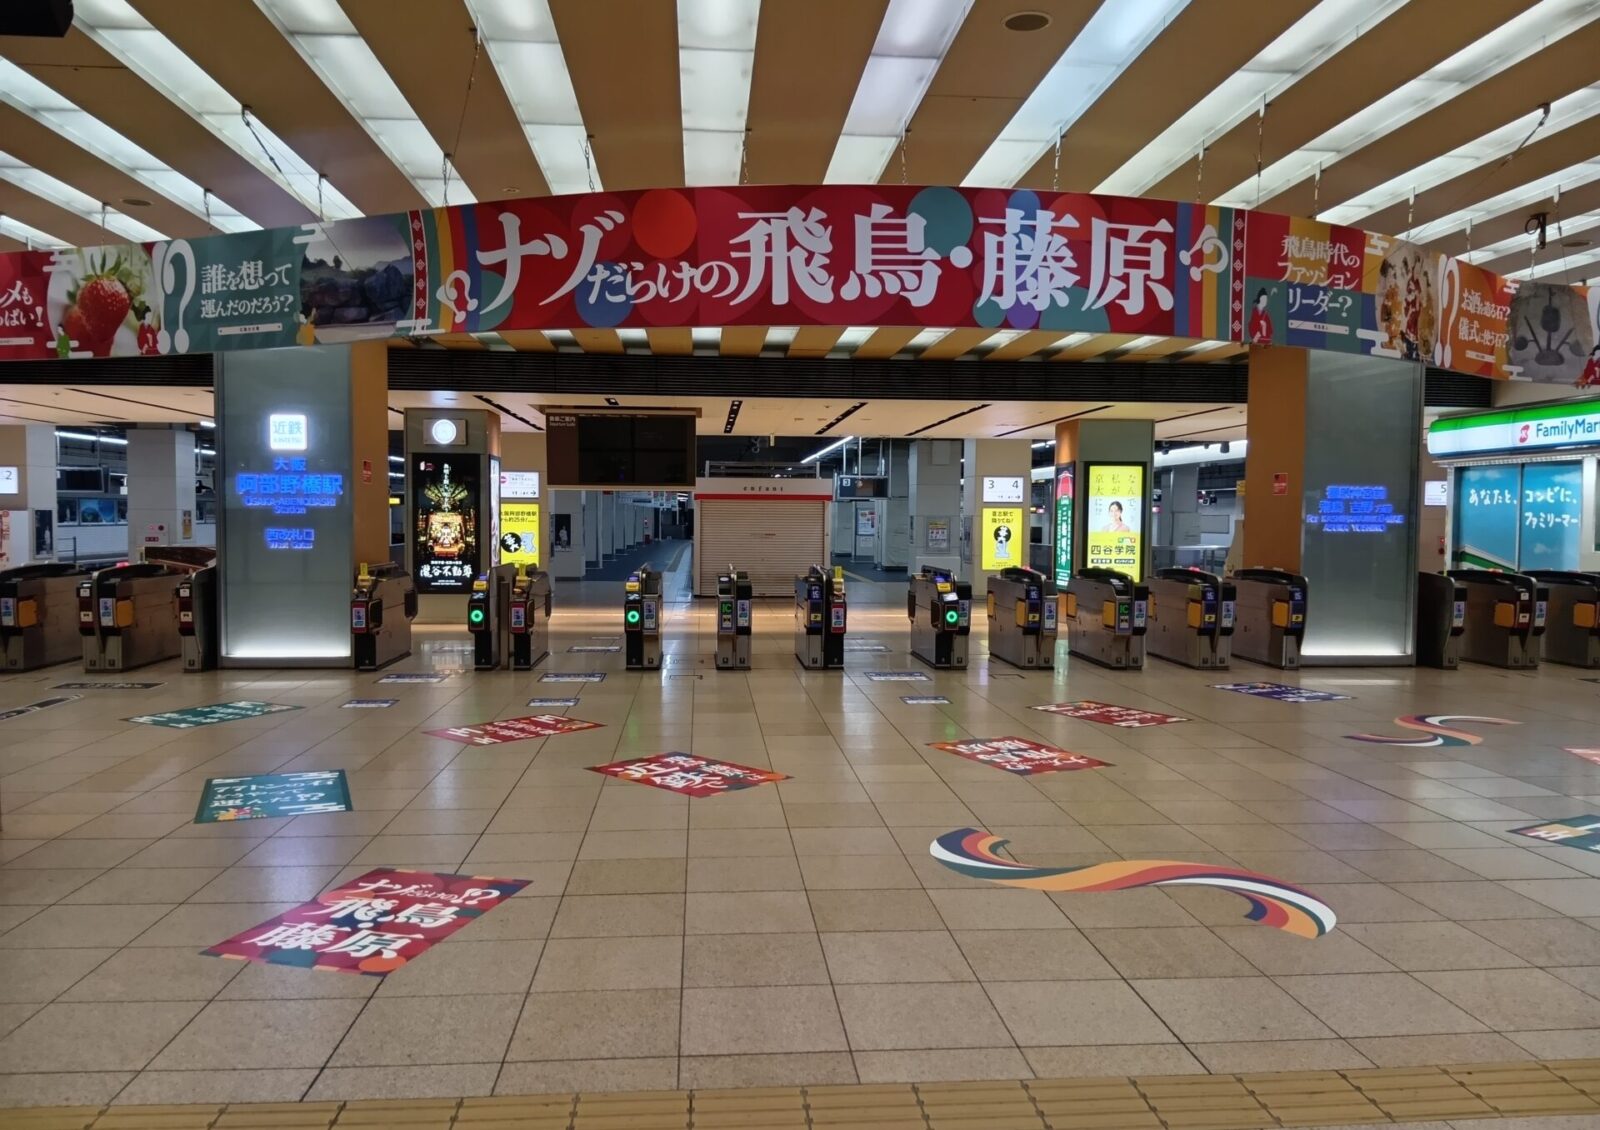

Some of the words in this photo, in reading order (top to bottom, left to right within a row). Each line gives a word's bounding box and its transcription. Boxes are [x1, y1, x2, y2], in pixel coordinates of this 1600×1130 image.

[1280, 236, 1360, 268] 飛鳥時代の
[201, 259, 292, 294] 誰を想って
[1277, 261, 1359, 290] ファッション
[201, 294, 294, 319] 運んだのだろう?
[1288, 287, 1353, 318] リーダー?
[273, 421, 303, 435] 近鉄
[1536, 418, 1600, 440] FamilyMar
[274, 456, 307, 472] 大阪
[5, 470, 12, 480] 2
[238, 474, 343, 495] 阿部野橋駅
[988, 480, 995, 489] 3
[1012, 480, 1019, 489] 4
[1441, 484, 1447, 494] 5
[1469, 488, 1517, 506] あなたと、
[1525, 486, 1577, 504] コンビに、
[266, 529, 314, 541] 西改札口
[1091, 545, 1136, 555] 四谷学院
[721, 603, 732, 613] IC
[1119, 604, 1129, 614] IC
[242, 921, 425, 959] 藤原
